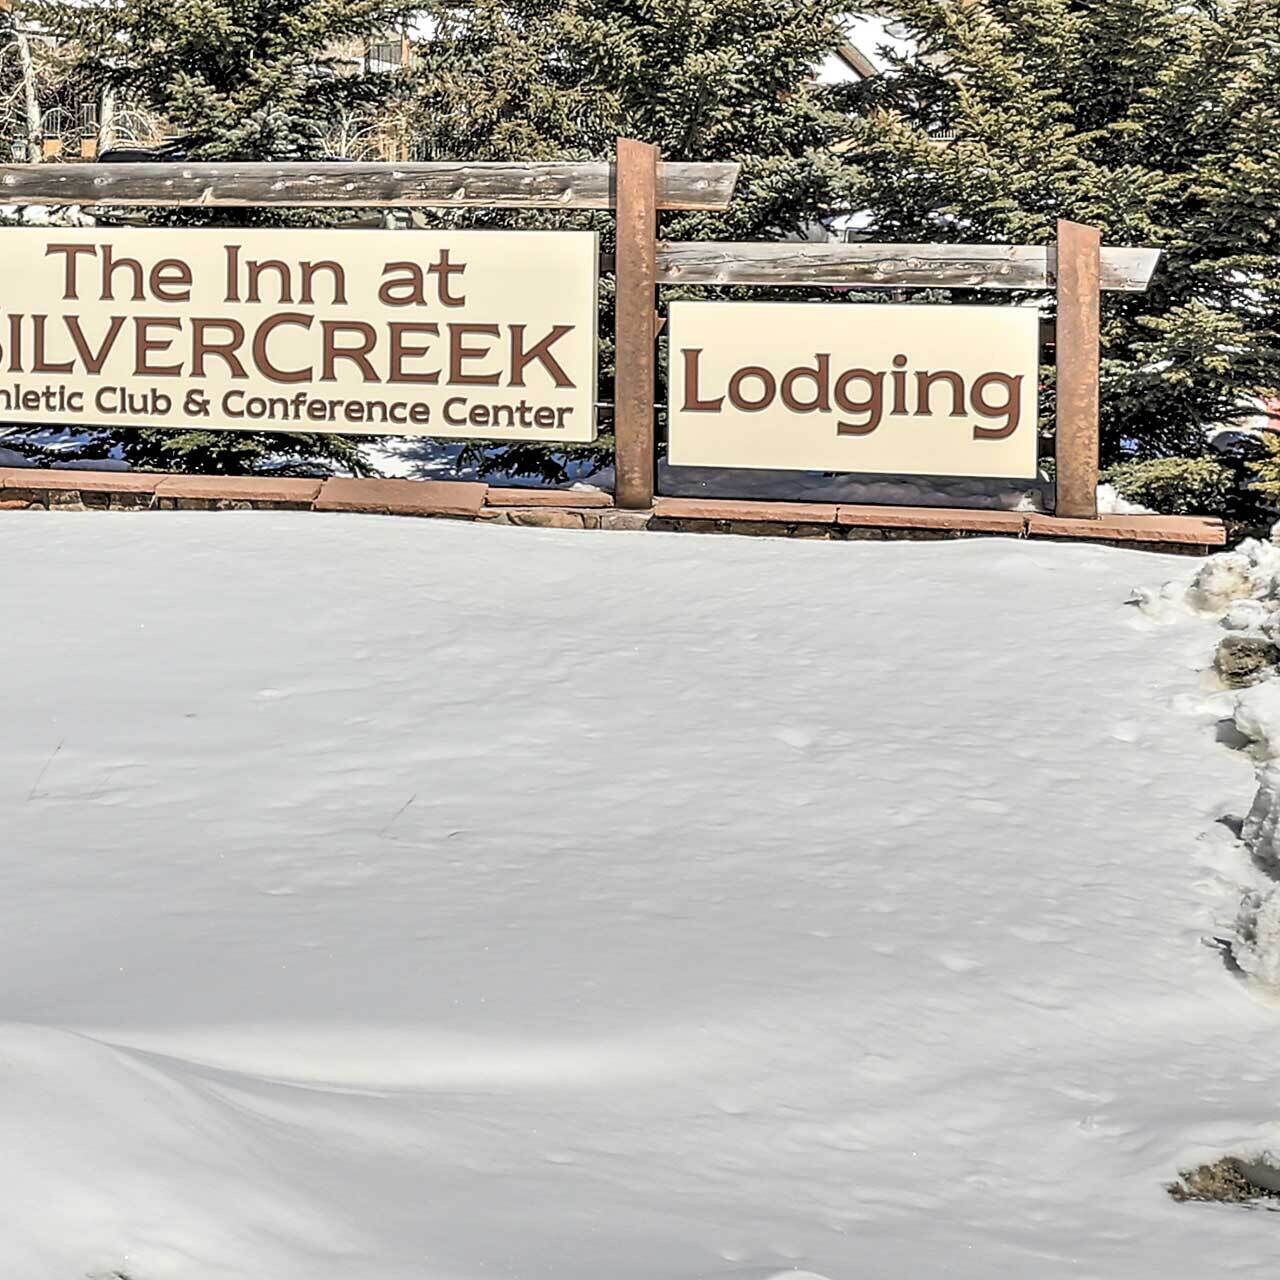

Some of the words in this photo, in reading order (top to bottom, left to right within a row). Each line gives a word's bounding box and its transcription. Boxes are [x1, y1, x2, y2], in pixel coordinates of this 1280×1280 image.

[45, 244, 192, 302] The
[224, 245, 348, 305] Inn
[378, 249, 467, 307] at
[95, 386, 172, 415] Club
[183, 389, 210, 416] &
[222, 390, 429, 424] Conference
[443, 397, 574, 428] Center
[680, 349, 1024, 440] Lodging
